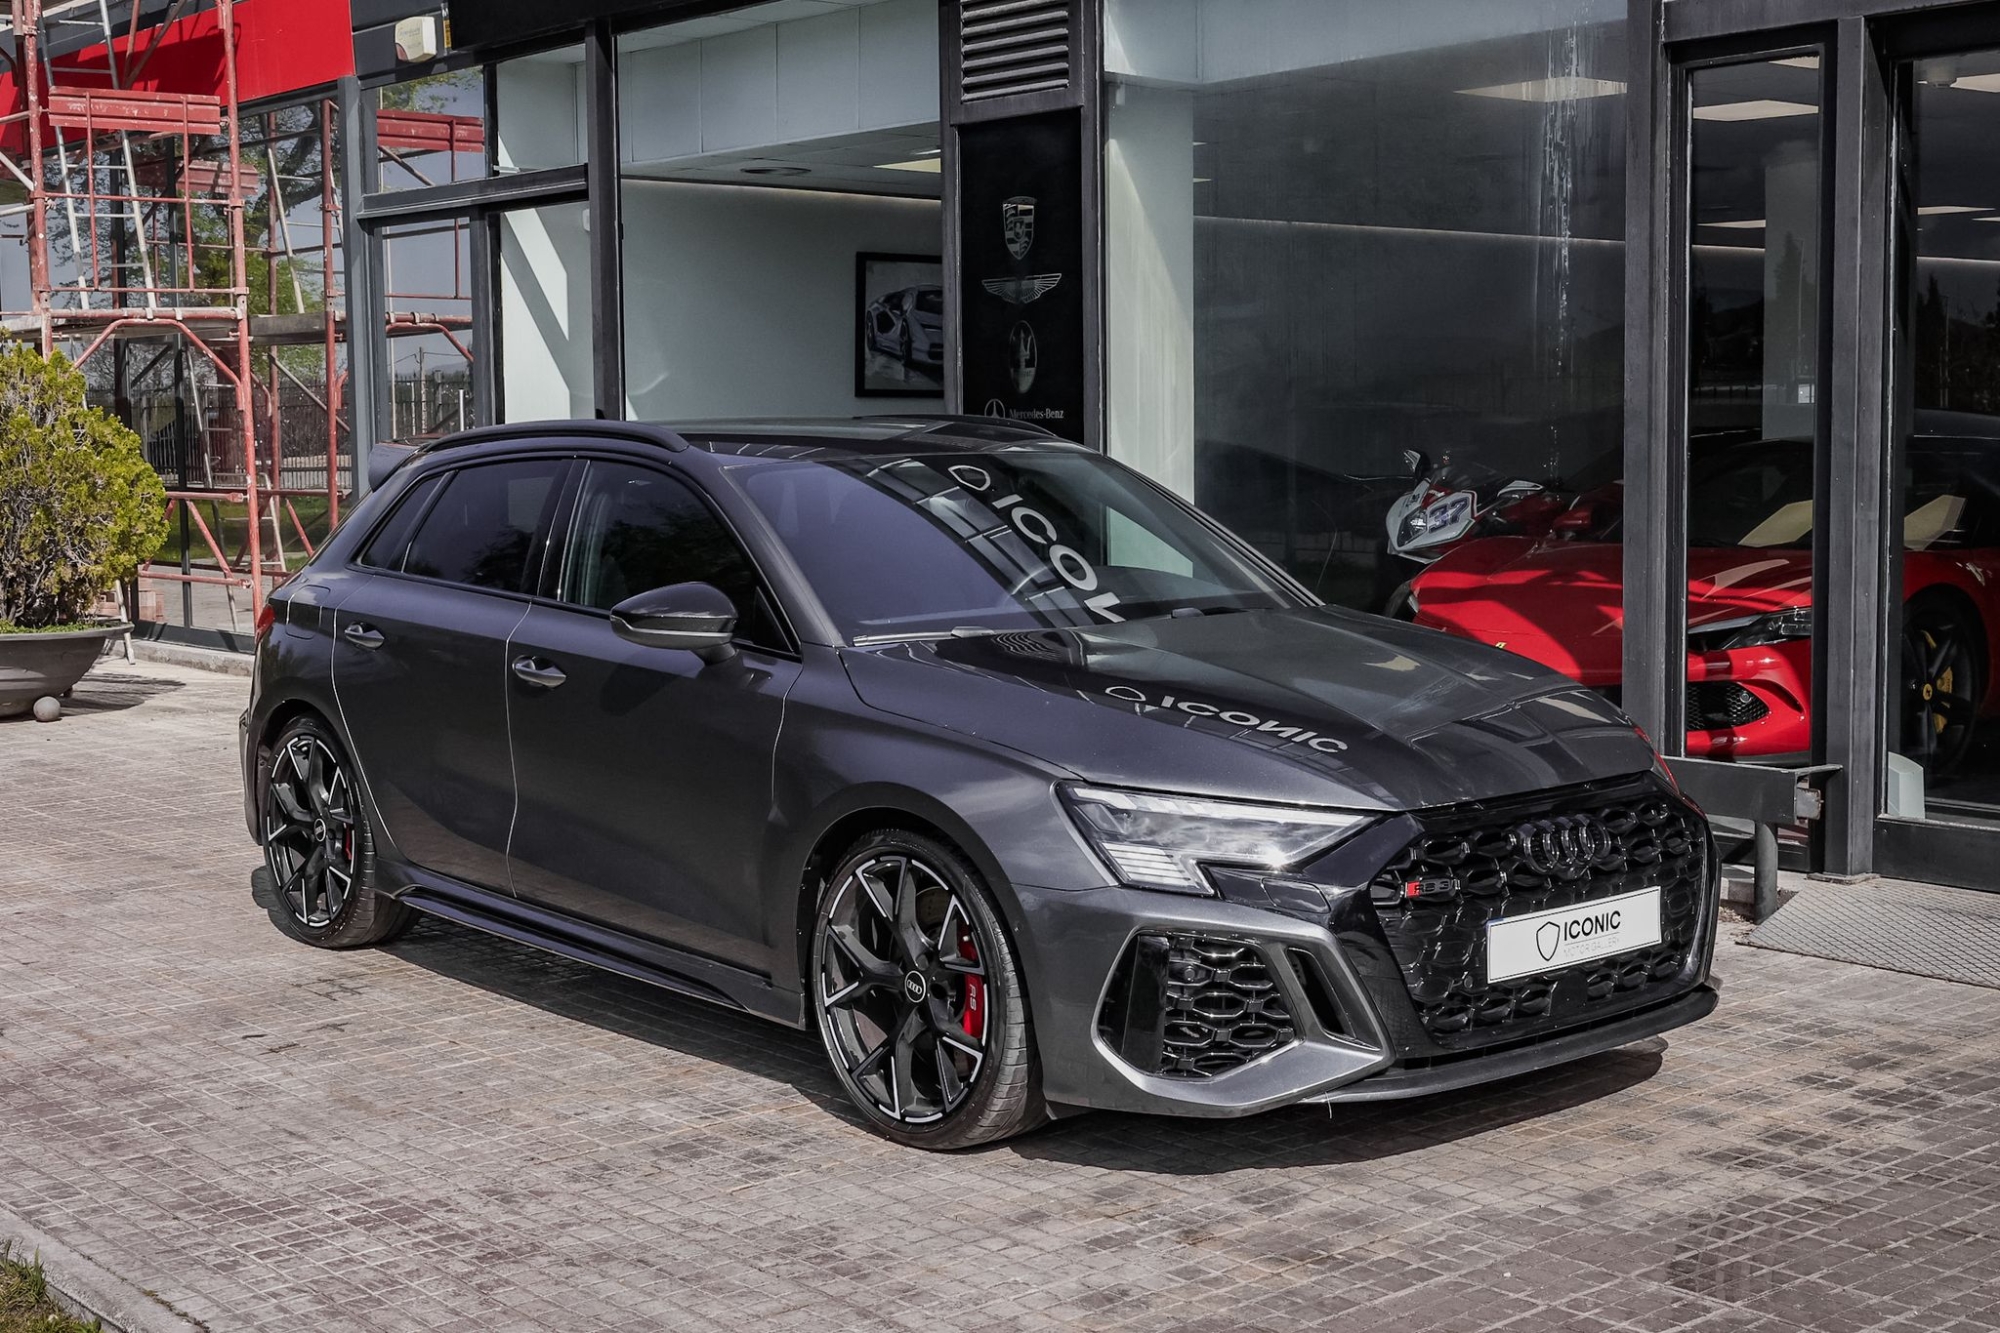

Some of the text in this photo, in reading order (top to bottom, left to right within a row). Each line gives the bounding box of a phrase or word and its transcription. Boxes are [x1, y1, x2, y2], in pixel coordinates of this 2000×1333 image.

[1009, 407, 1064, 419] Mercedes-Benz
[1428, 497, 1469, 534] 37
[1563, 910, 1621, 941] ICONIC
[1563, 943, 1590, 957] MOTOR
[969, 984, 977, 1011] RS
